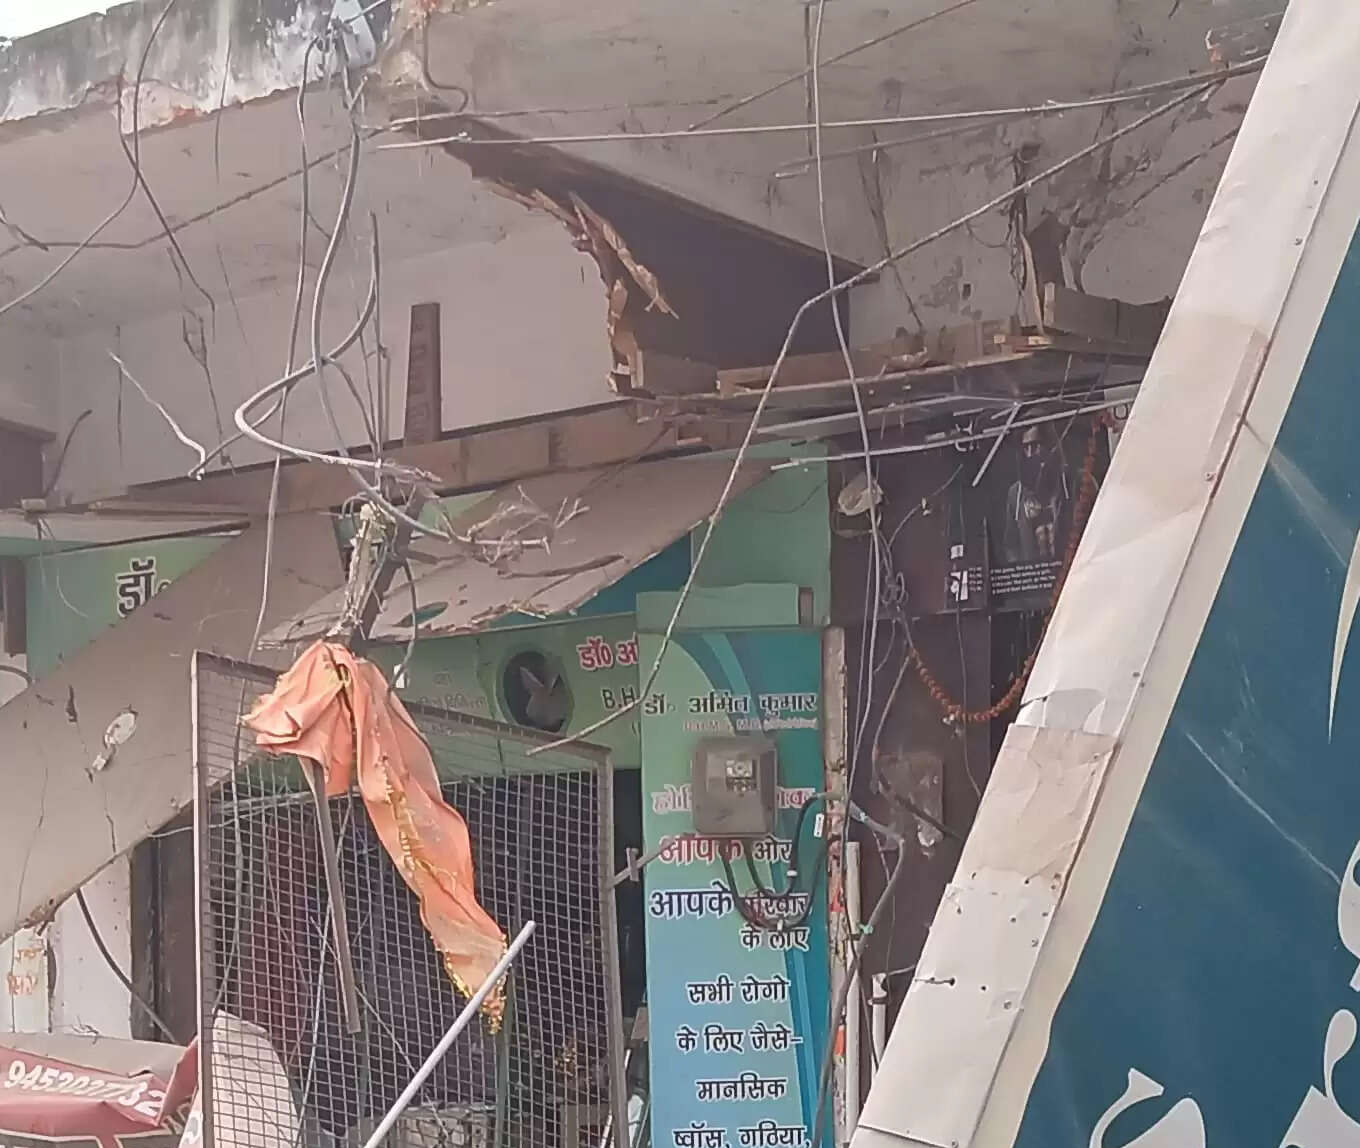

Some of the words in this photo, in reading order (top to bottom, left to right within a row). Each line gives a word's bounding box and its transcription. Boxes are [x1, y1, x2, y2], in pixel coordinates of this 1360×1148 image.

[690, 690, 750, 714] अमित
[758, 693, 817, 717] कुमार
[649, 880, 734, 919] आपके
[687, 973, 734, 1003] सभी
[741, 974, 791, 1003] रोगो
[676, 1023, 698, 1053] के
[704, 1023, 743, 1052] लिए
[696, 1072, 787, 1101] मानसिक
